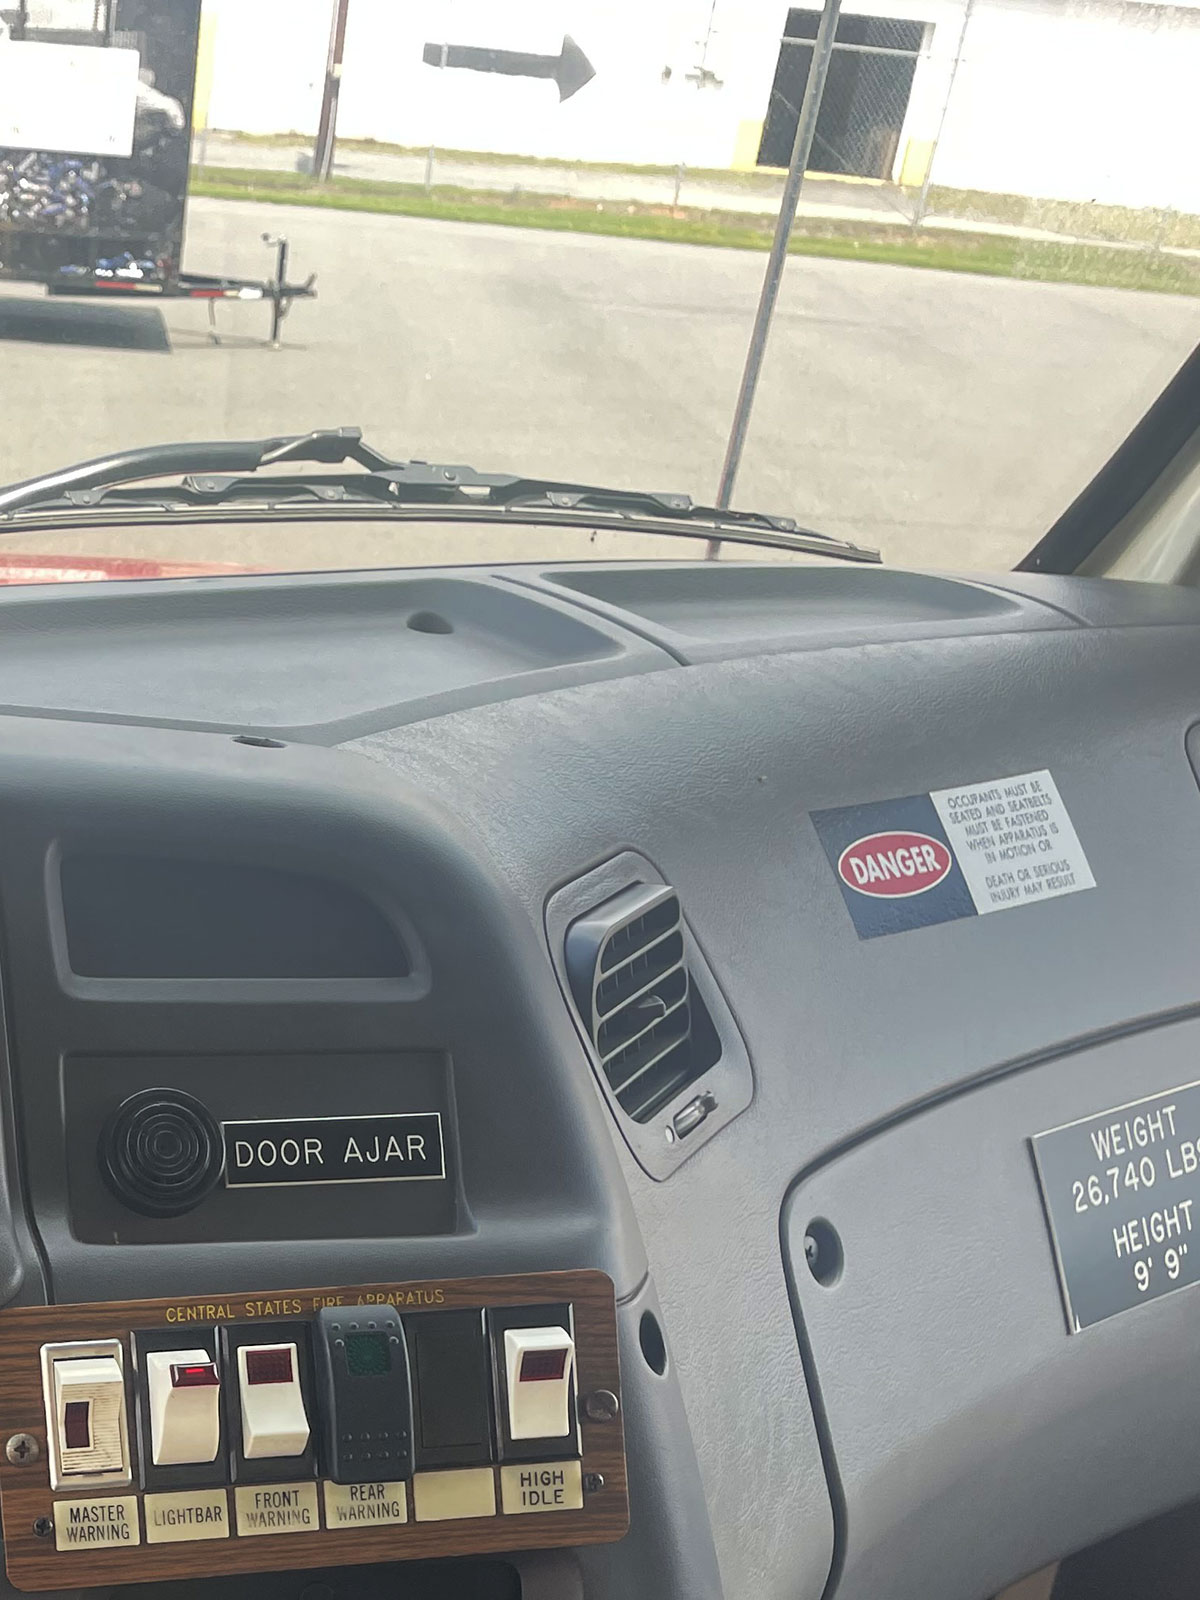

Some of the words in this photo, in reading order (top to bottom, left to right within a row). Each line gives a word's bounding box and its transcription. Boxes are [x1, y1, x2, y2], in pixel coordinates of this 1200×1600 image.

[948, 789, 1002, 809] OCCUPANTS
[1004, 784, 1028, 798] MUST
[949, 808, 982, 824] SEATED
[986, 804, 1006, 818] AND
[1008, 794, 1052, 812] SEATBELTS
[964, 822, 990, 837] MUST
[1005, 810, 1049, 828] FASTENED
[966, 836, 995, 851] WHEN
[1000, 826, 1048, 846] APPARATUS
[848, 844, 942, 885] DANGER
[1000, 844, 1036, 860] MOTION
[985, 871, 1015, 889] DEATH
[1033, 860, 1070, 878] SERIOUS
[990, 888, 1020, 902] INJURY
[1024, 880, 1043, 894] MAY
[1048, 872, 1076, 890] RESULT
[1090, 1104, 1176, 1162] WEIGHT
[235, 1138, 324, 1168] DOOR
[344, 1135, 427, 1164] AJAR
[1072, 1156, 1156, 1213] 26,740
[1112, 1200, 1193, 1258] HEIGHT
[1134, 1257, 1153, 1292] 9'
[1164, 1244, 1188, 1280] 9"
[166, 1304, 235, 1322] CENTRAL
[246, 1300, 302, 1317] STATES
[357, 1289, 444, 1308] APPARATUS
[520, 1470, 564, 1488] HIGH
[255, 1490, 300, 1510] FRONT
[350, 1484, 386, 1502] REAR
[522, 1488, 564, 1506] IDLE
[70, 1504, 125, 1524] MASTER
[153, 1506, 222, 1526] LIGHTBAR
[246, 1508, 311, 1528] WARNING
[336, 1501, 400, 1522] WARNING
[66, 1522, 130, 1543] WARNING
